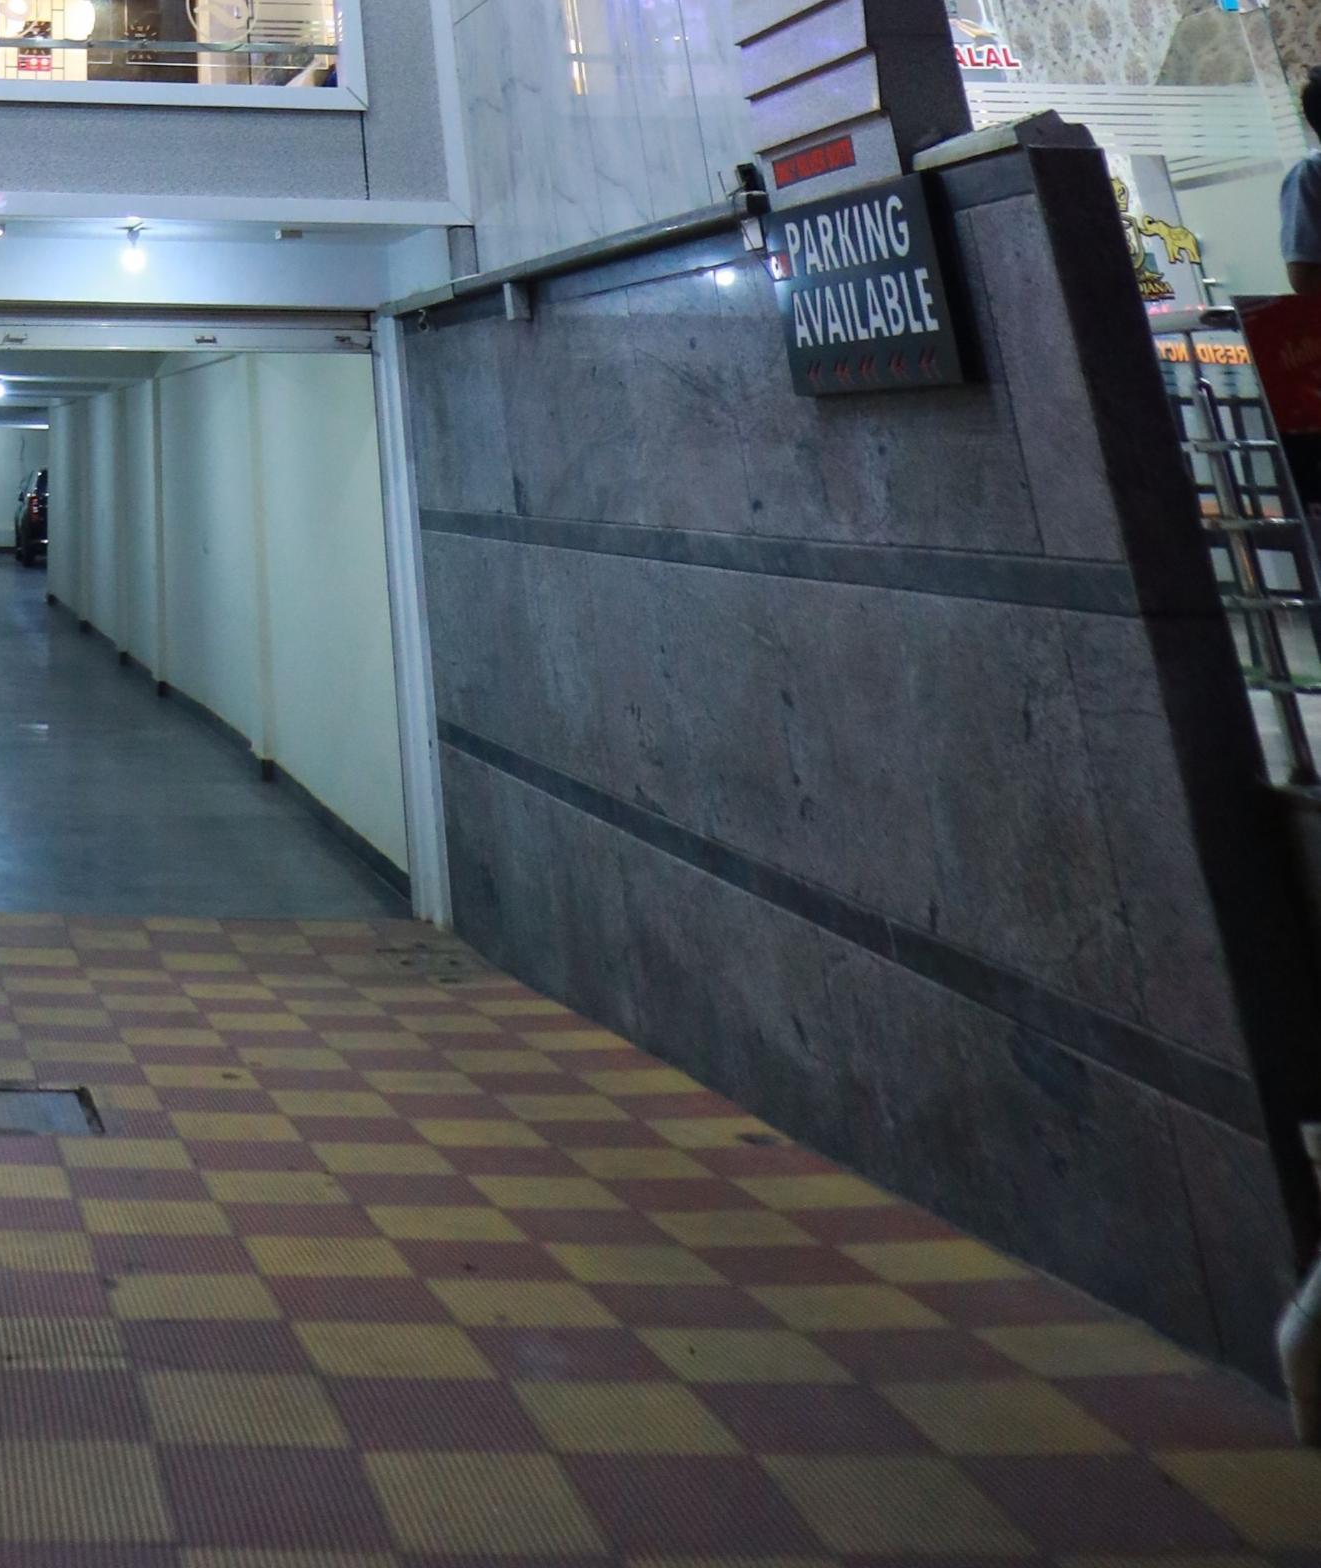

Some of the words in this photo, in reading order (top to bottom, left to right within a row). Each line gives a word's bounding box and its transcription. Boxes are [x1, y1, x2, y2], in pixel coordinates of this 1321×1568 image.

[954, 45, 1020, 69] ALAL
[784, 194, 911, 278] PARKING
[791, 266, 941, 349] AVAILABLE
